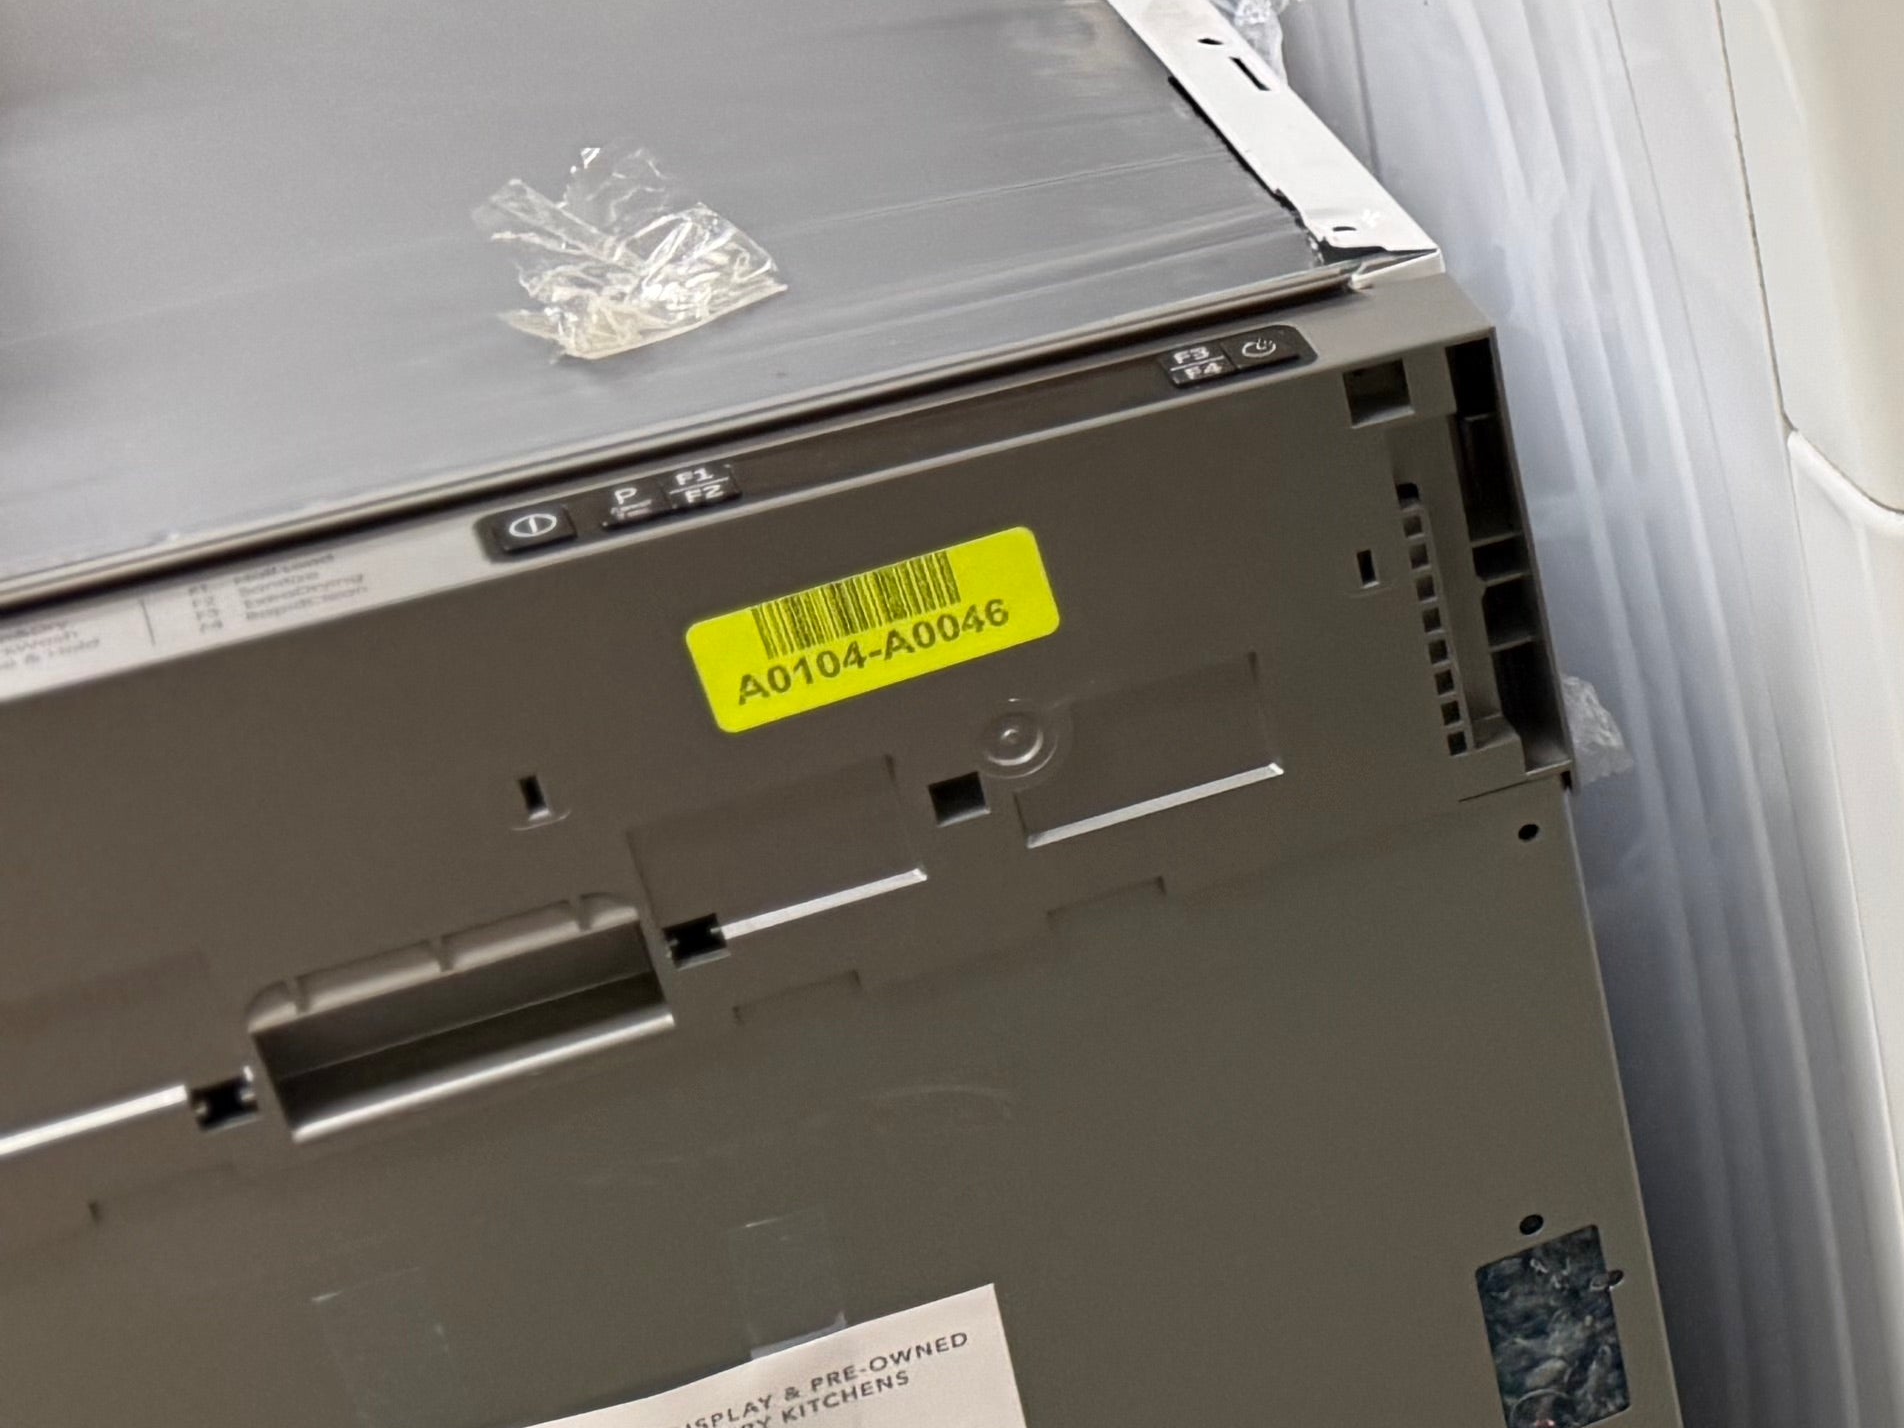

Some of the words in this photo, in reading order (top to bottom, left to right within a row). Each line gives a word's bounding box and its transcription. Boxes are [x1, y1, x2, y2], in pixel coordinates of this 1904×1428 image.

[1173, 345, 1211, 365] F3
[1183, 362, 1224, 381] F4
[676, 467, 715, 486] F1
[614, 487, 638, 505] P
[685, 484, 725, 504] F2
[735, 596, 1011, 706] A0104-A0046
[785, 1385, 800, 1404] &
[810, 1332, 970, 1395] PRE-OWNED
[780, 1370, 911, 1427] KITCHENS
